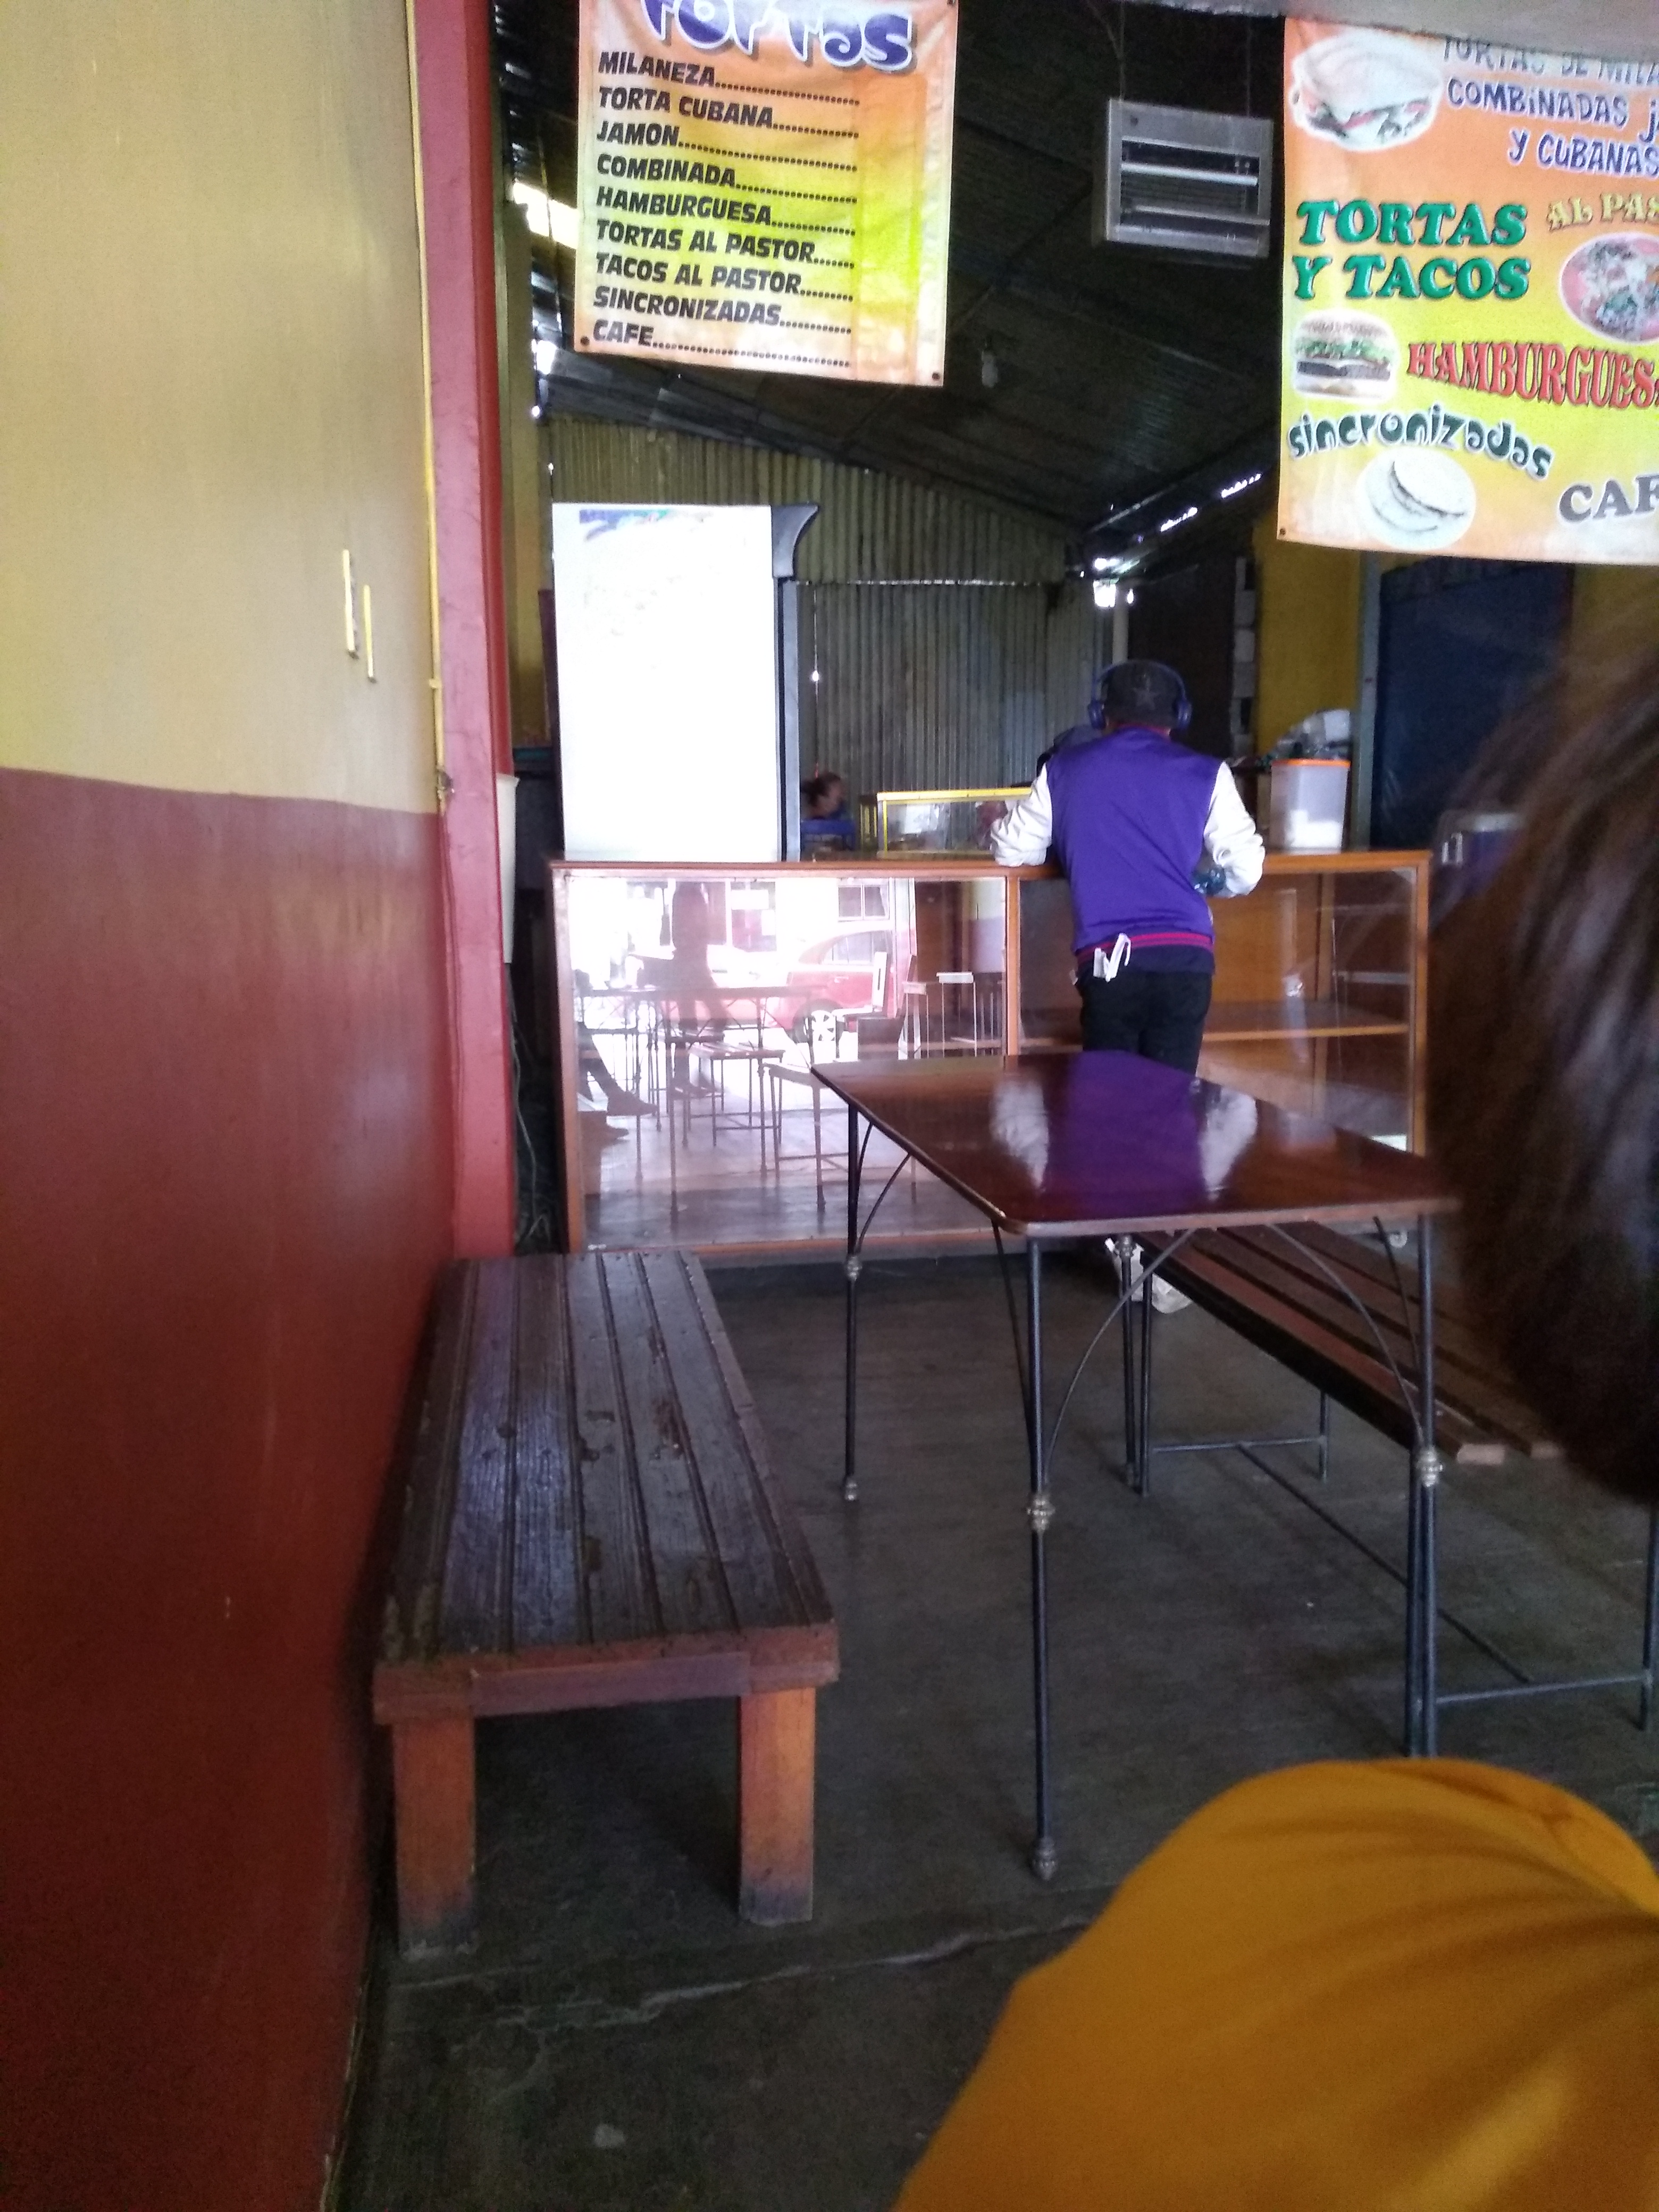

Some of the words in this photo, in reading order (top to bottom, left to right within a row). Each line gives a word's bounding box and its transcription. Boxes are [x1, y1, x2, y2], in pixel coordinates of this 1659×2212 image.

[598, 52, 715, 88] MILANEZA
[599, 87, 671, 112] TORTA
[679, 96, 774, 129] CUBANA
[597, 120, 679, 146] JAMON
[597, 154, 736, 188] COMBINADA
[597, 186, 772, 225] HAMBURGUESA
[1297, 200, 1527, 247] TORTAS
[1546, 196, 1593, 232] AL
[597, 219, 683, 251] TORTAS
[689, 231, 717, 253] AL
[725, 233, 816, 263] PASTOR
[596, 253, 668, 283] TACOS
[675, 263, 703, 286] AL
[711, 266, 802, 295] PASTOR
[1292, 256, 1331, 300] Y
[1343, 255, 1531, 300] TACOS
[593, 286, 781, 326] SINCRONIZADAS
[593, 320, 654, 347] CAFE
[1407, 341, 1659, 409] HAMBURGUES
